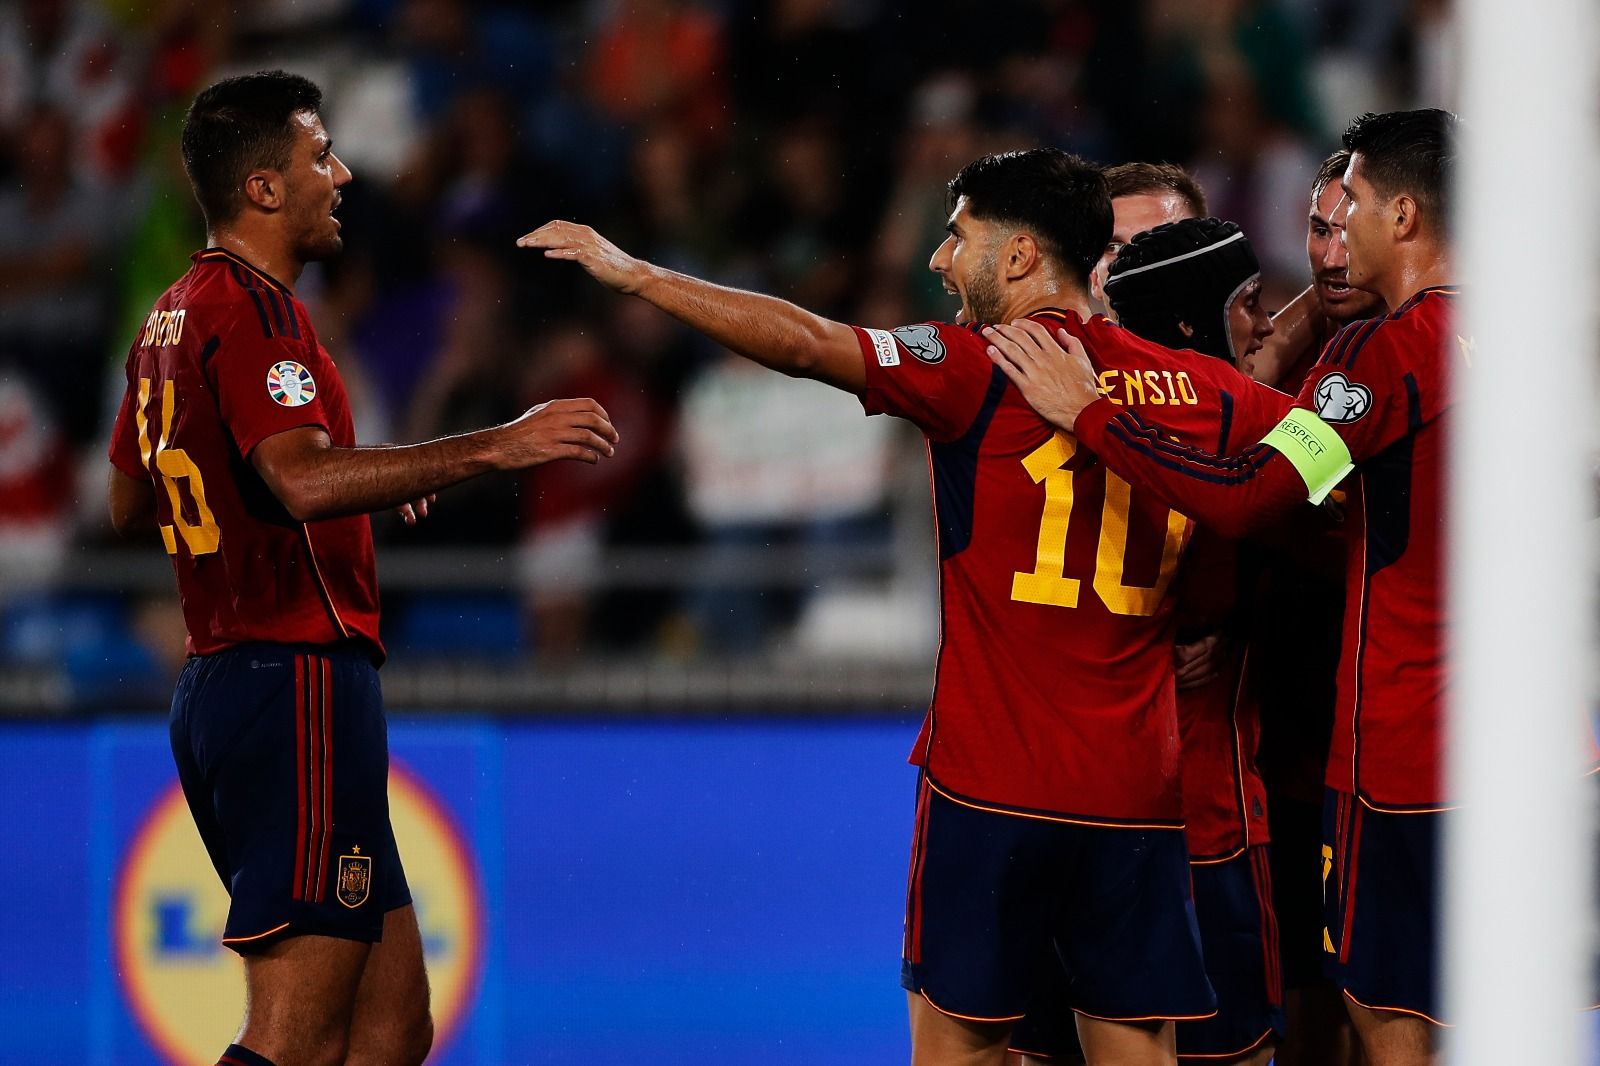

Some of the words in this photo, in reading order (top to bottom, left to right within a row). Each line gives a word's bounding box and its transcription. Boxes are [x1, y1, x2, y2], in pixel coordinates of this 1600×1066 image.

[878, 332, 892, 364] ATION
[1093, 369, 1198, 405] ENSIO
[1280, 421, 1324, 456] RESPECT
[136, 377, 220, 555] 16
[1011, 431, 1187, 616] 10
